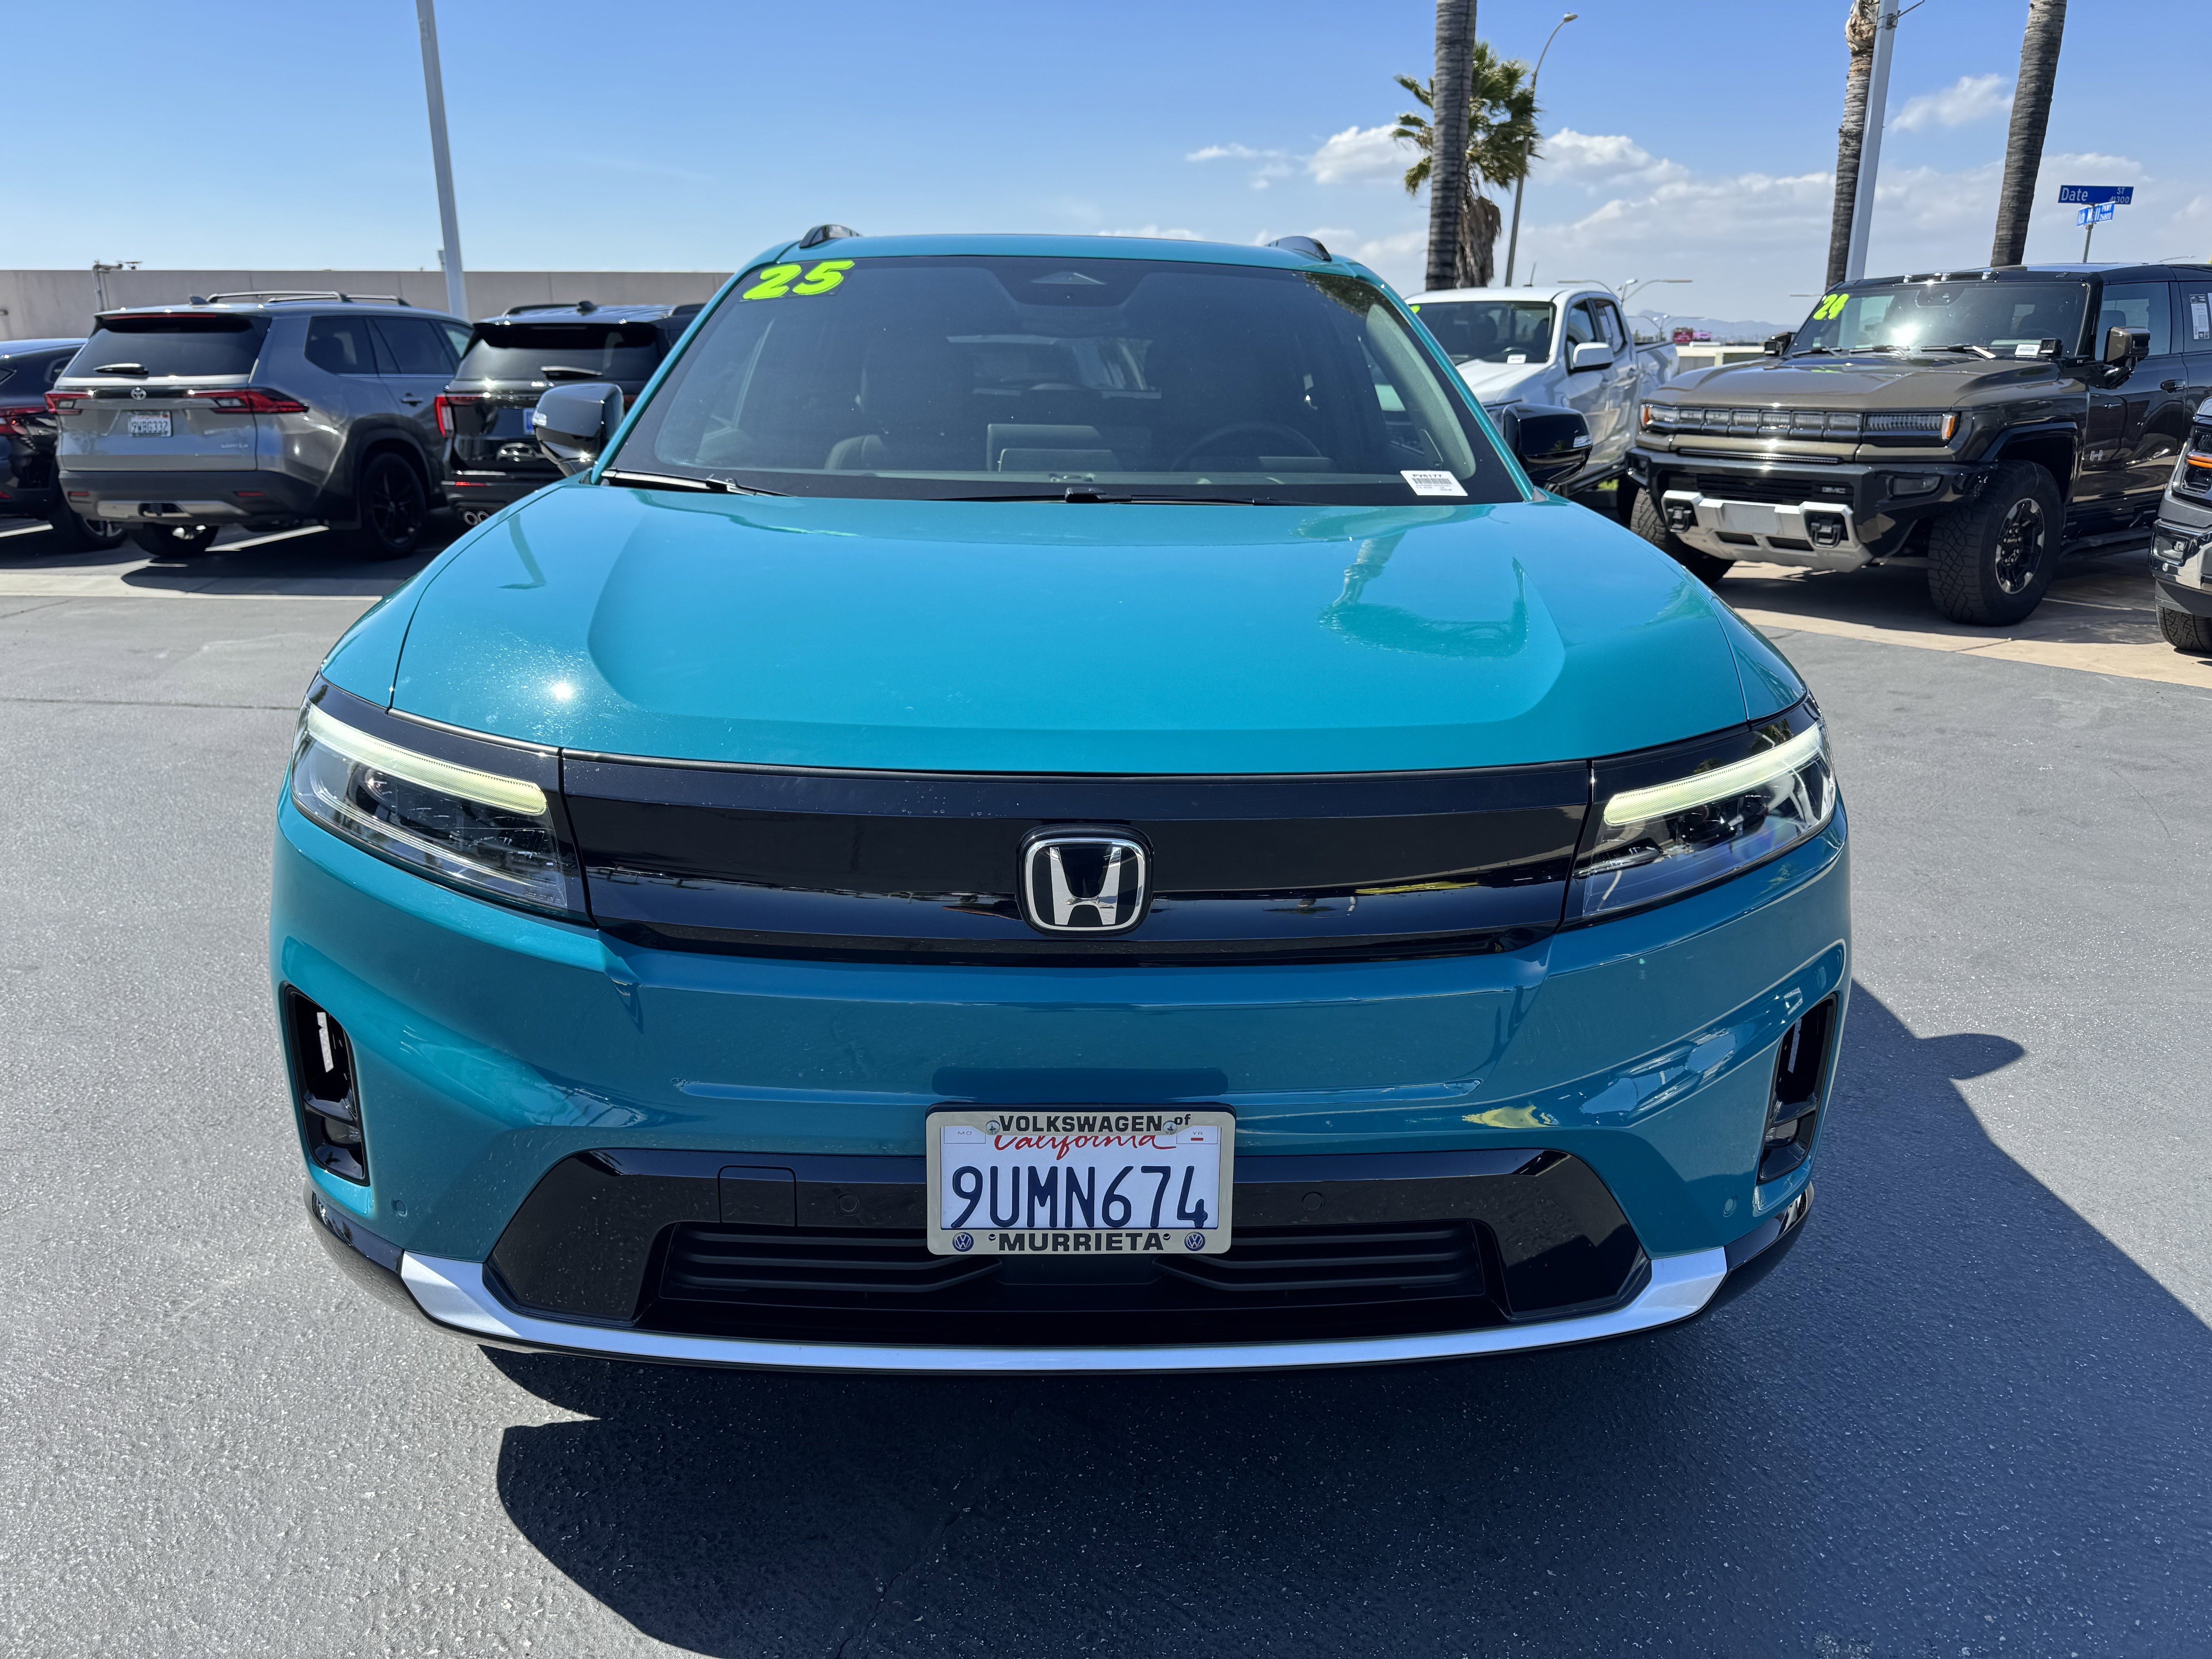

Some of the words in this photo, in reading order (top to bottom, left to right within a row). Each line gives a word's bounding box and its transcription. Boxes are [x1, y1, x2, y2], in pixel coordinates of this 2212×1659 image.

[2061, 187, 2088, 201] Date
[743, 260, 855, 300] 25
[1813, 294, 1849, 320] 24
[999, 1115, 1162, 1132] VOLKSWAGEN
[1174, 1114, 1191, 1125] of
[951, 1166, 1208, 1228] 9UMN674
[999, 1233, 1164, 1251] MURRIETA
